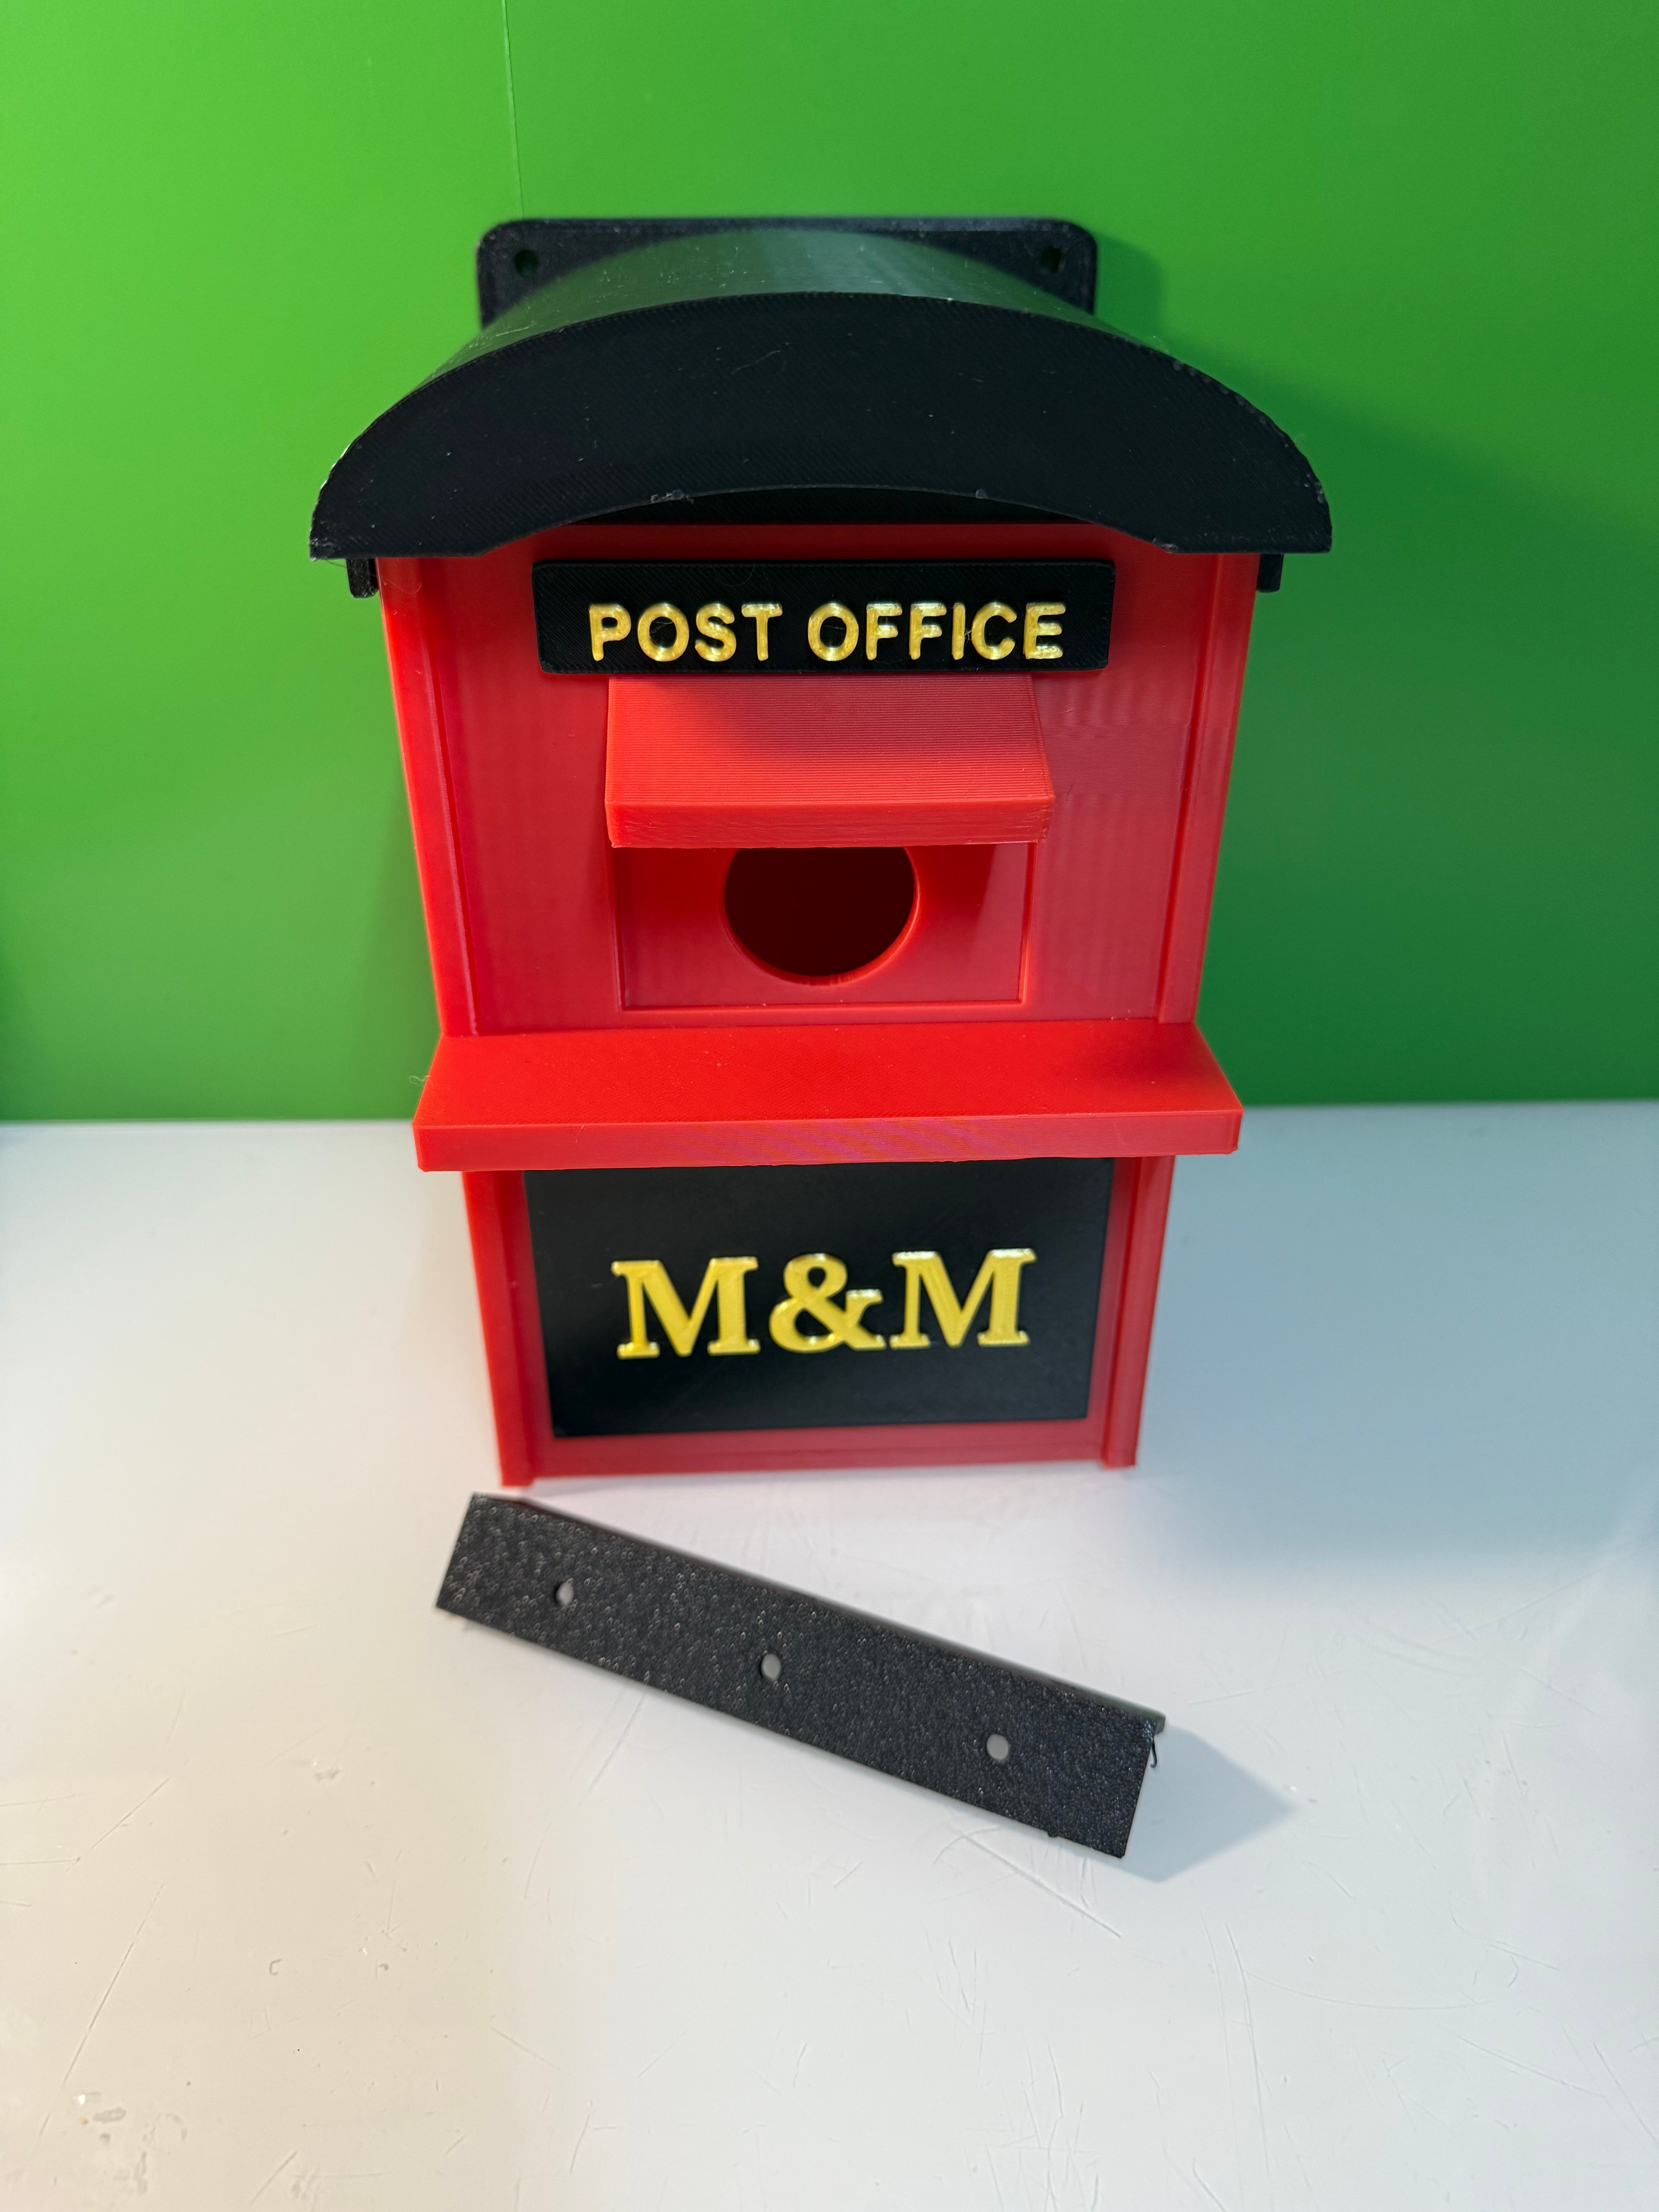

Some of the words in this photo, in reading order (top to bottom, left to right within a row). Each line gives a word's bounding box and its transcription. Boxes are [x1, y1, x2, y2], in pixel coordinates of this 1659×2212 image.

[589, 603, 783, 662] POST
[808, 601, 1066, 661] OFFICE
[611, 1248, 1037, 1360] M&M
